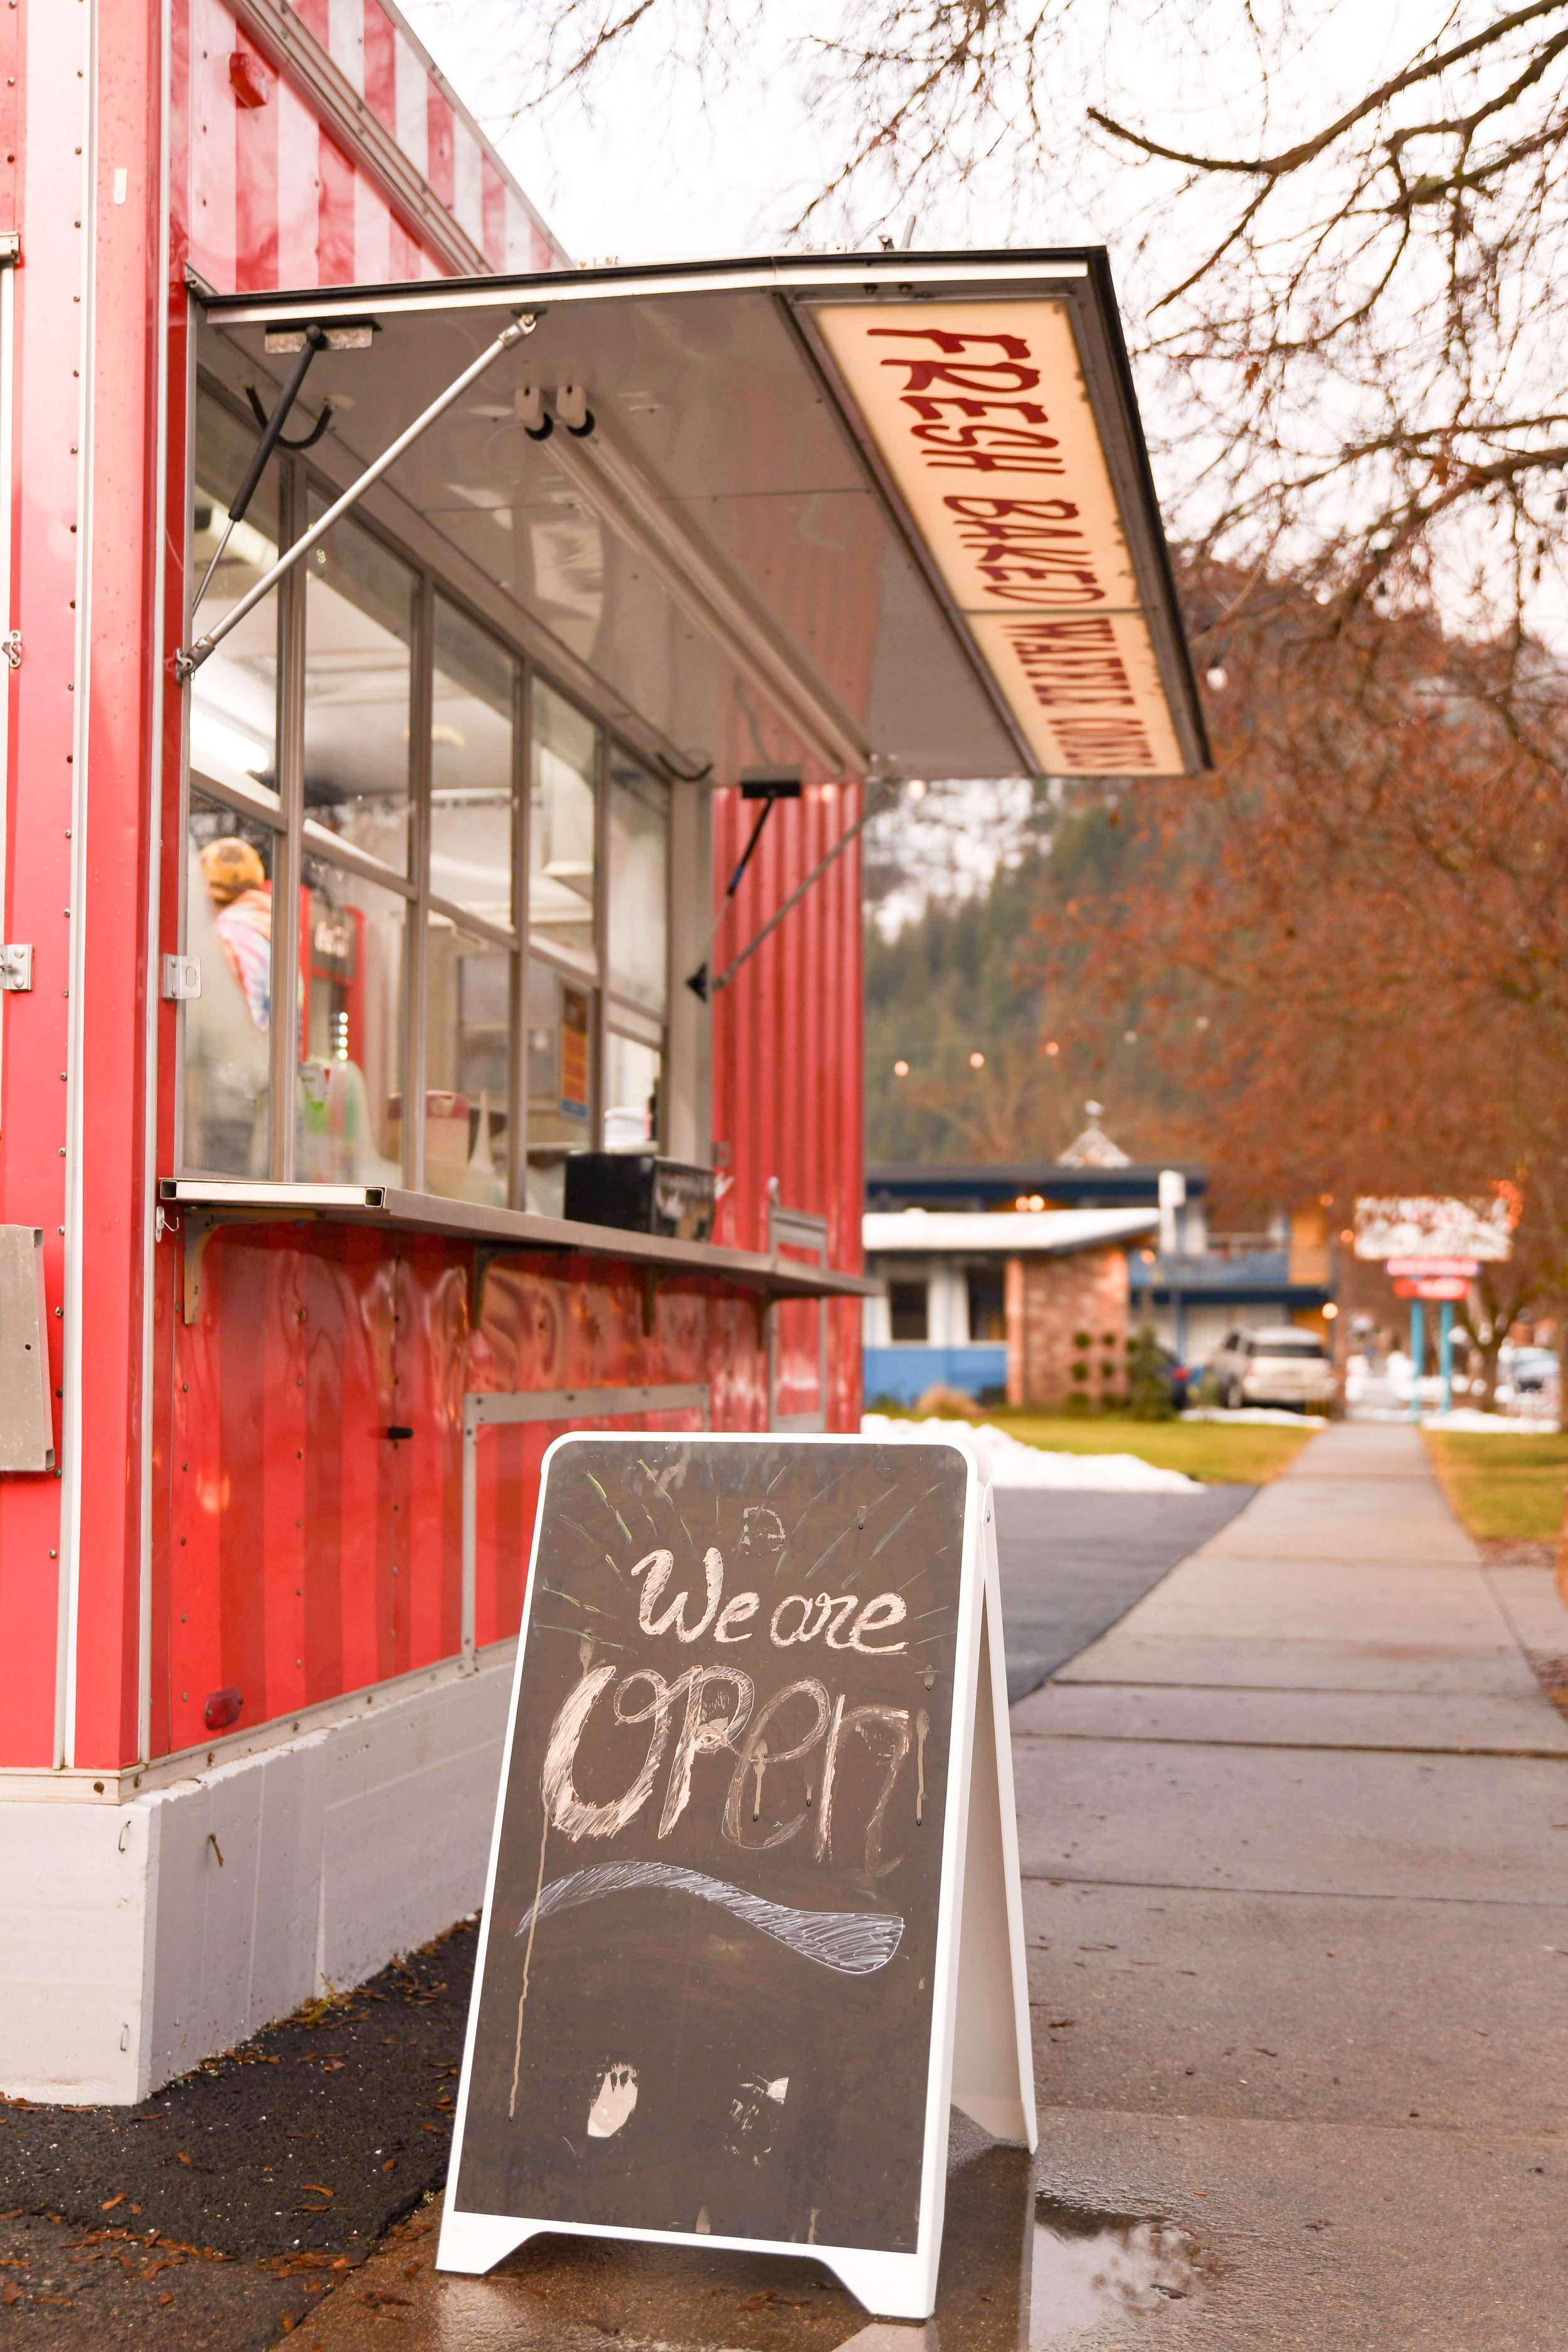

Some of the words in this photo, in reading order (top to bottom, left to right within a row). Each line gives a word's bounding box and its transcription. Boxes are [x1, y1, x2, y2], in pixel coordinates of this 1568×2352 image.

[867, 328, 1066, 475] FRESH
[944, 495, 1107, 605] BAKED
[1002, 618, 1136, 706] WAFFLE
[1047, 717, 1157, 770] CONES
[630, 1547, 760, 1643] We
[770, 1591, 909, 1655] are
